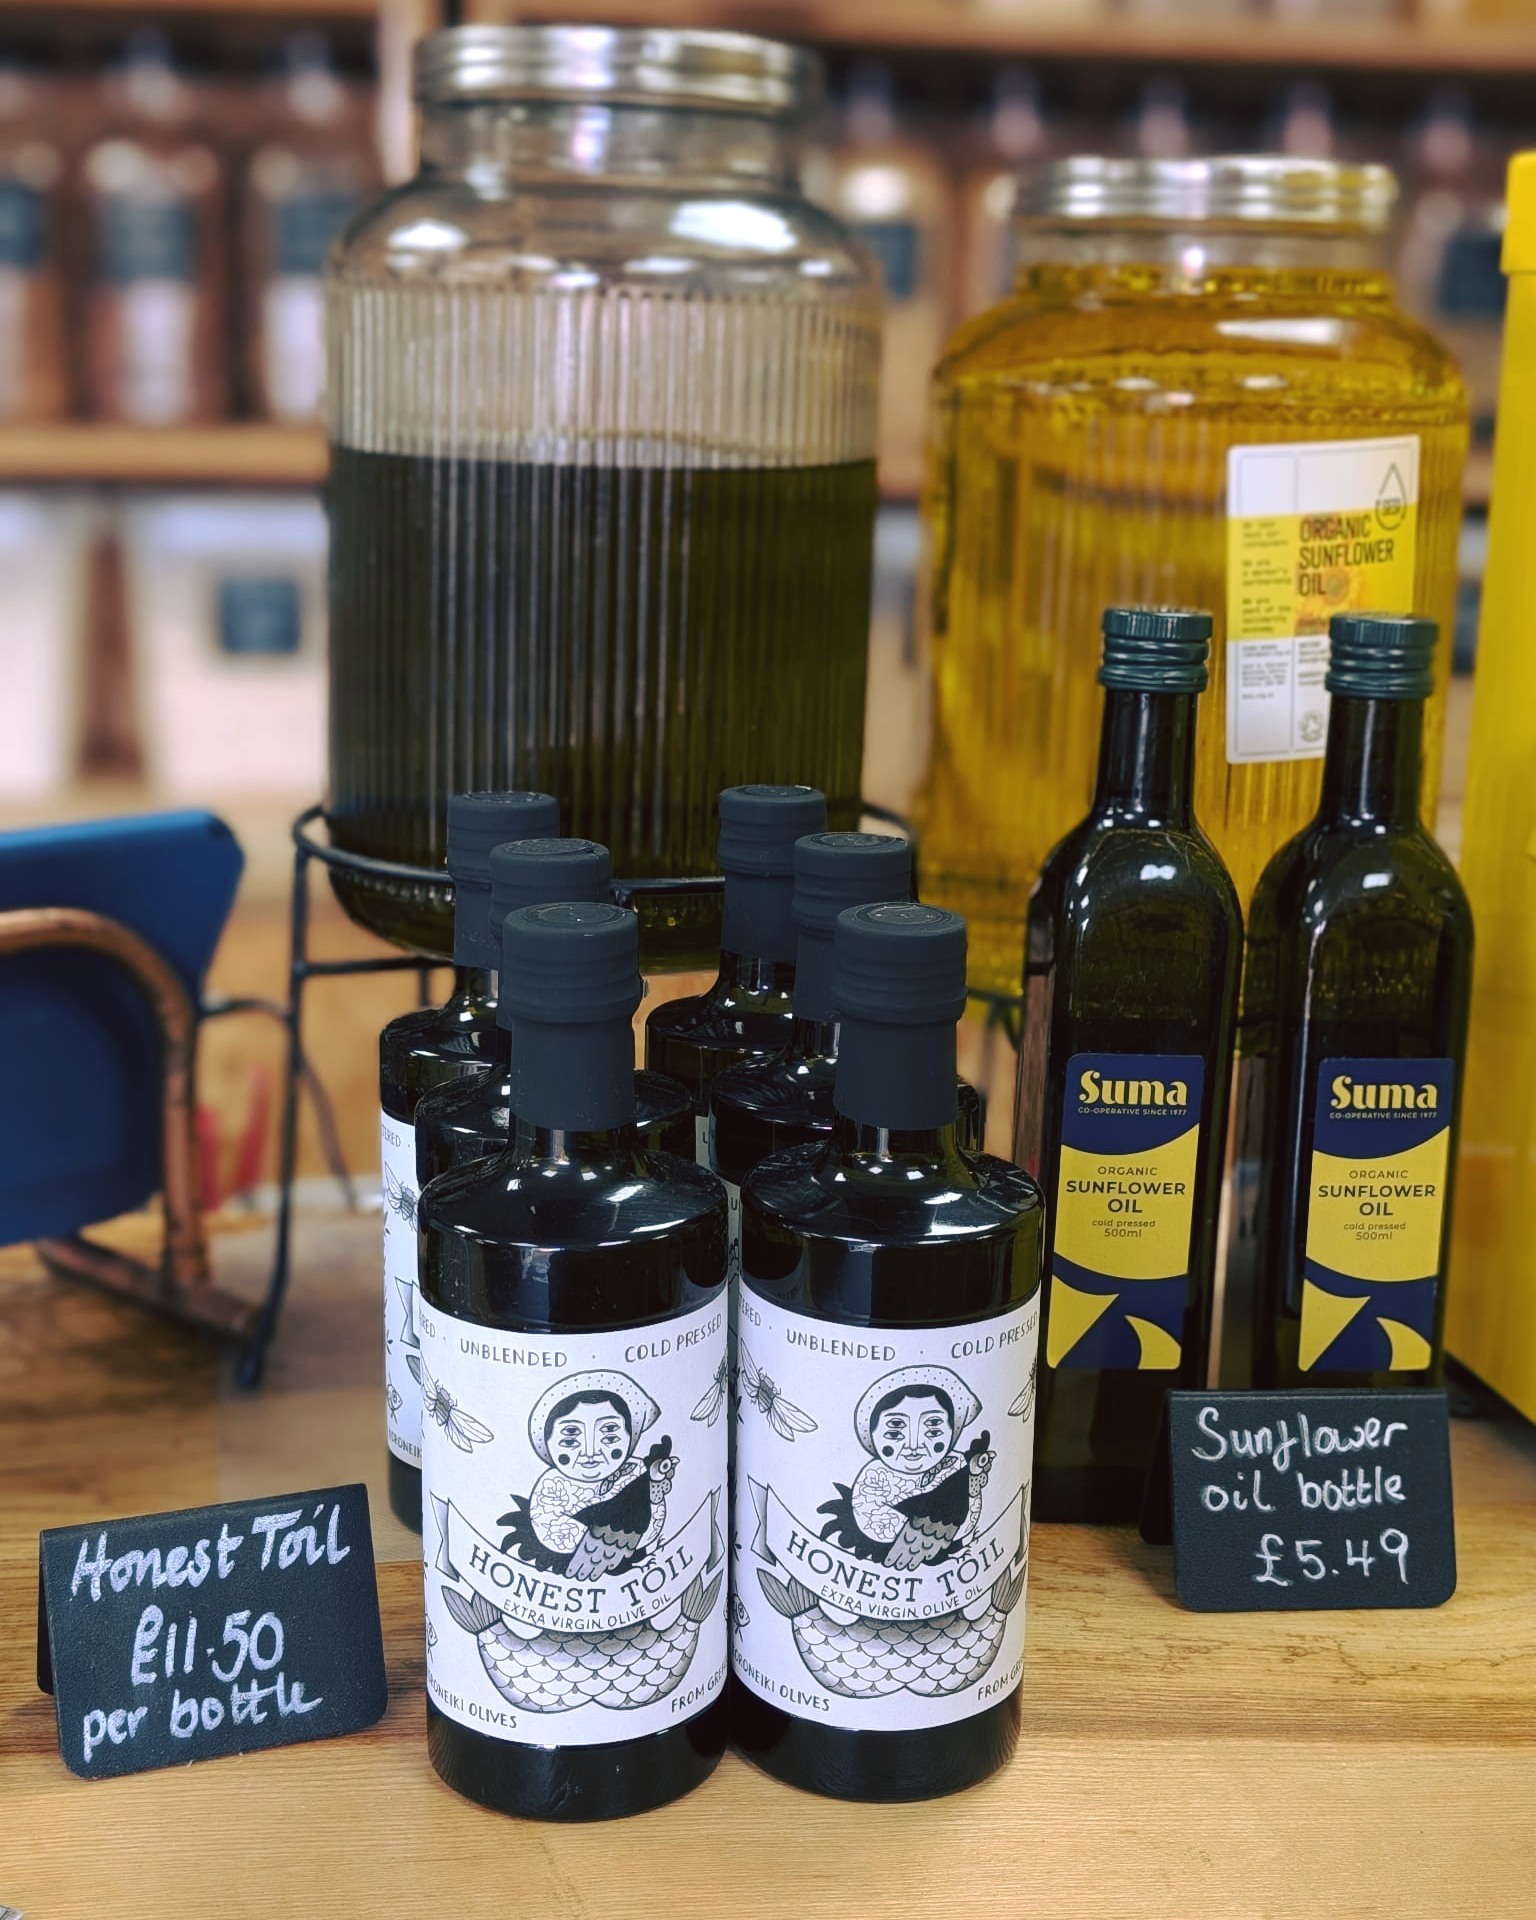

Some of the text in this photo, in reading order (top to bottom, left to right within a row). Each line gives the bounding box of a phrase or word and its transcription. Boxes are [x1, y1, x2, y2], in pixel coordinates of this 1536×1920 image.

[1299, 516, 1371, 542] ORGANIC
[1298, 539, 1395, 570] SUNFLOWER
[1298, 572, 1327, 597] OIL
[1079, 1069, 1187, 1106] Suma
[1330, 1074, 1438, 1109] Suma
[1077, 1106, 1141, 1115] CO-OPERATIVE
[1142, 1108, 1167, 1116] SINCE
[1329, 1111, 1391, 1120] CO-OPERATIVE
[1393, 1111, 1417, 1120] SINCE
[1097, 1166, 1158, 1176] ORGANIC
[1348, 1169, 1409, 1180] ORGANIC
[1066, 1180, 1186, 1195] SUNFLOWER
[1318, 1184, 1436, 1198] SUNFLOWER
[1107, 1198, 1144, 1214] OIL
[1358, 1202, 1394, 1217] OIL
[1091, 1219, 1156, 1229] cold pressed
[1103, 1228, 1142, 1238] 500ml
[1343, 1222, 1407, 1232] cold pressed
[1355, 1231, 1393, 1241] 500ml
[459, 1337, 567, 1368] UNBLENDED
[624, 1338, 672, 1363] COLD
[676, 1312, 722, 1352] PRESSED
[786, 1328, 896, 1361] UNBLENDED
[951, 1336, 995, 1359] COLD
[1191, 1406, 1408, 1474] Sunflower
[1203, 1465, 1408, 1512] oil bottle
[71, 1502, 351, 1601] Honest Toil
[1253, 1527, 1409, 1587] £5.49
[468, 1542, 694, 1614] HONEST TOIL
[786, 1530, 1005, 1603] HONEST TOIL
[503, 1593, 672, 1630] EXTRA VIRGIN OLIVE OIL
[820, 1584, 984, 1619] EXTRA VIRGIN OLIVE OIL
[130, 1603, 285, 1687] £11.50
[671, 1683, 705, 1713] FROM
[779, 1684, 830, 1712] OLIVES
[977, 1672, 1009, 1701] FROM
[83, 1671, 324, 1763] per bottle
[468, 1702, 517, 1729] OLIVES
